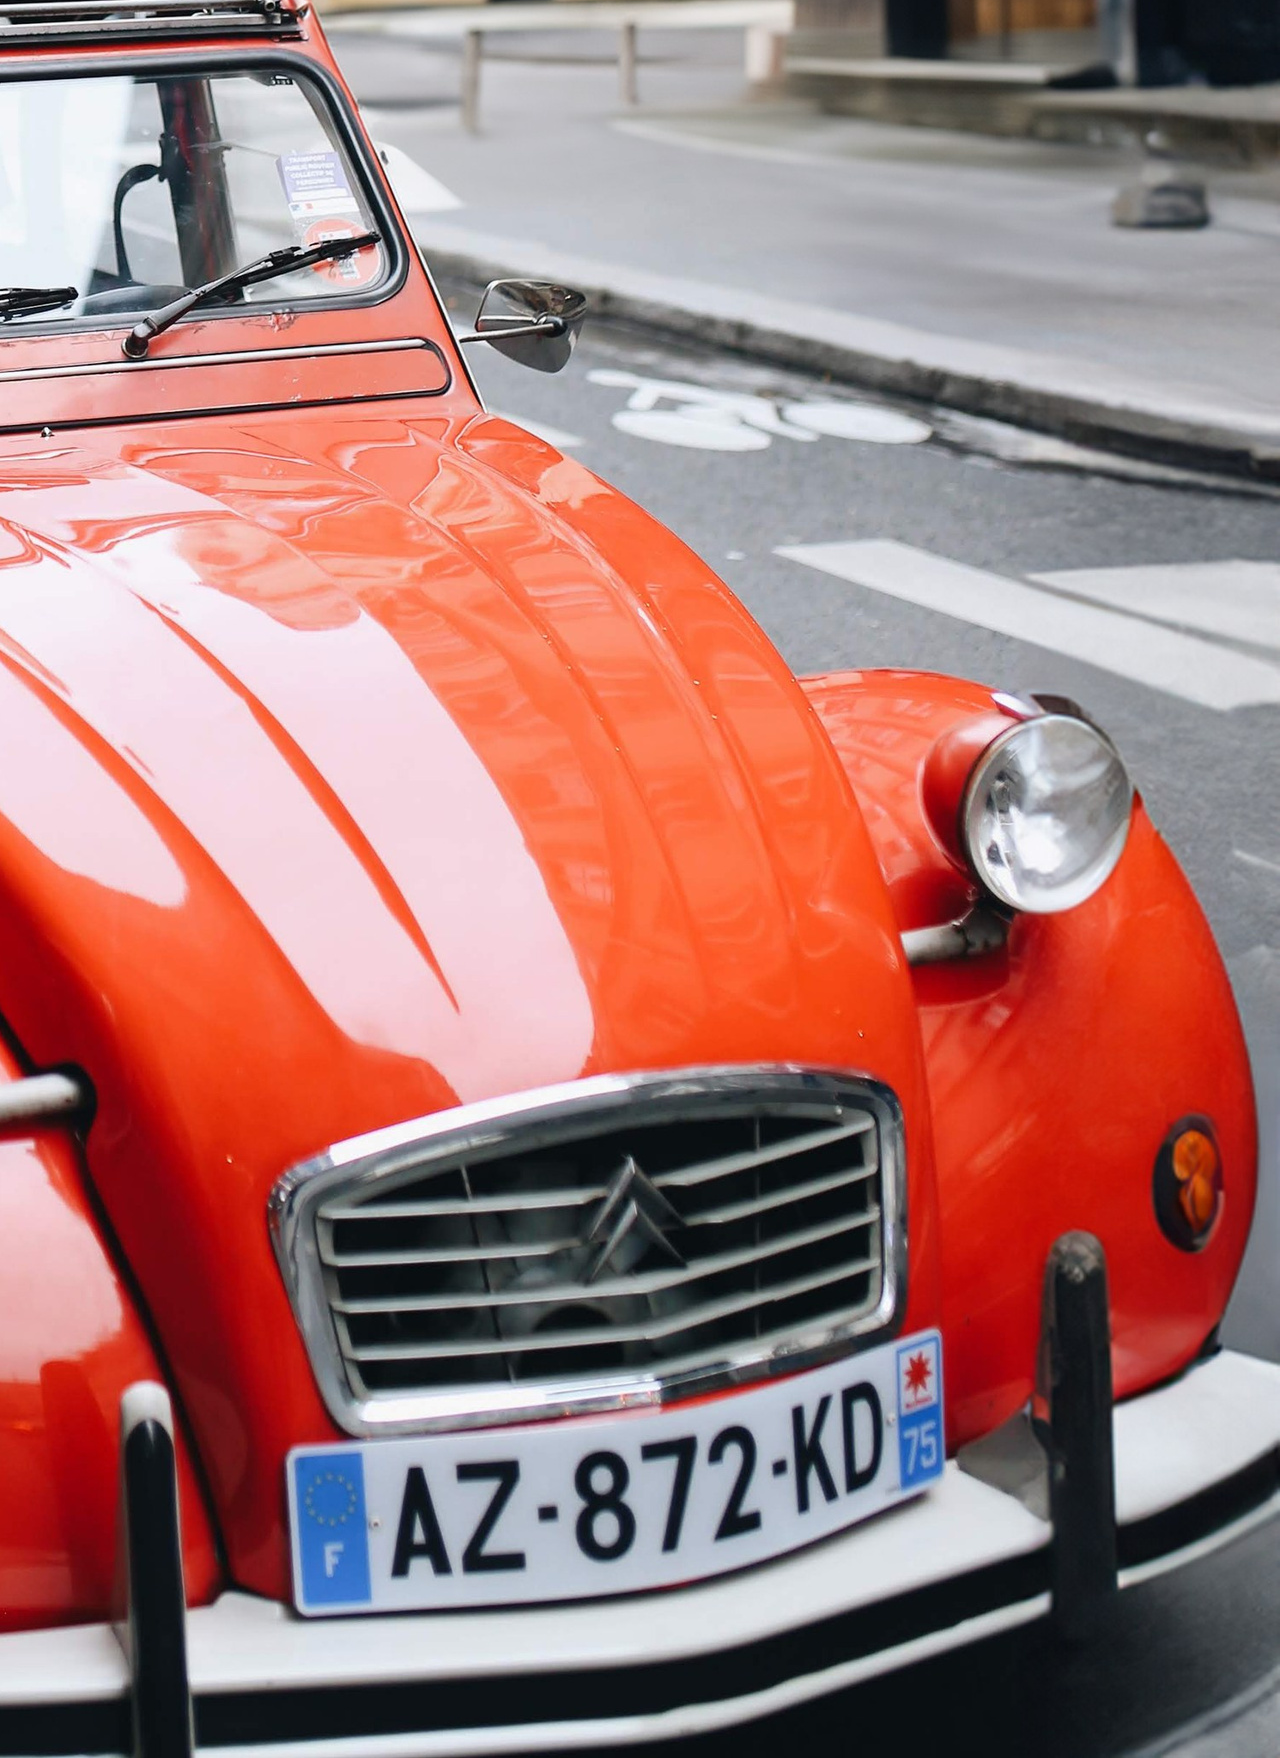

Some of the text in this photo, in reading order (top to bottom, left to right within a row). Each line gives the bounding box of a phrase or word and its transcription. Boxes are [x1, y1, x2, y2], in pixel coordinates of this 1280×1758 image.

[903, 1419, 937, 1476] 75
[390, 1380, 883, 1579] AZ-872-KD
[323, 1543, 345, 1578] F
